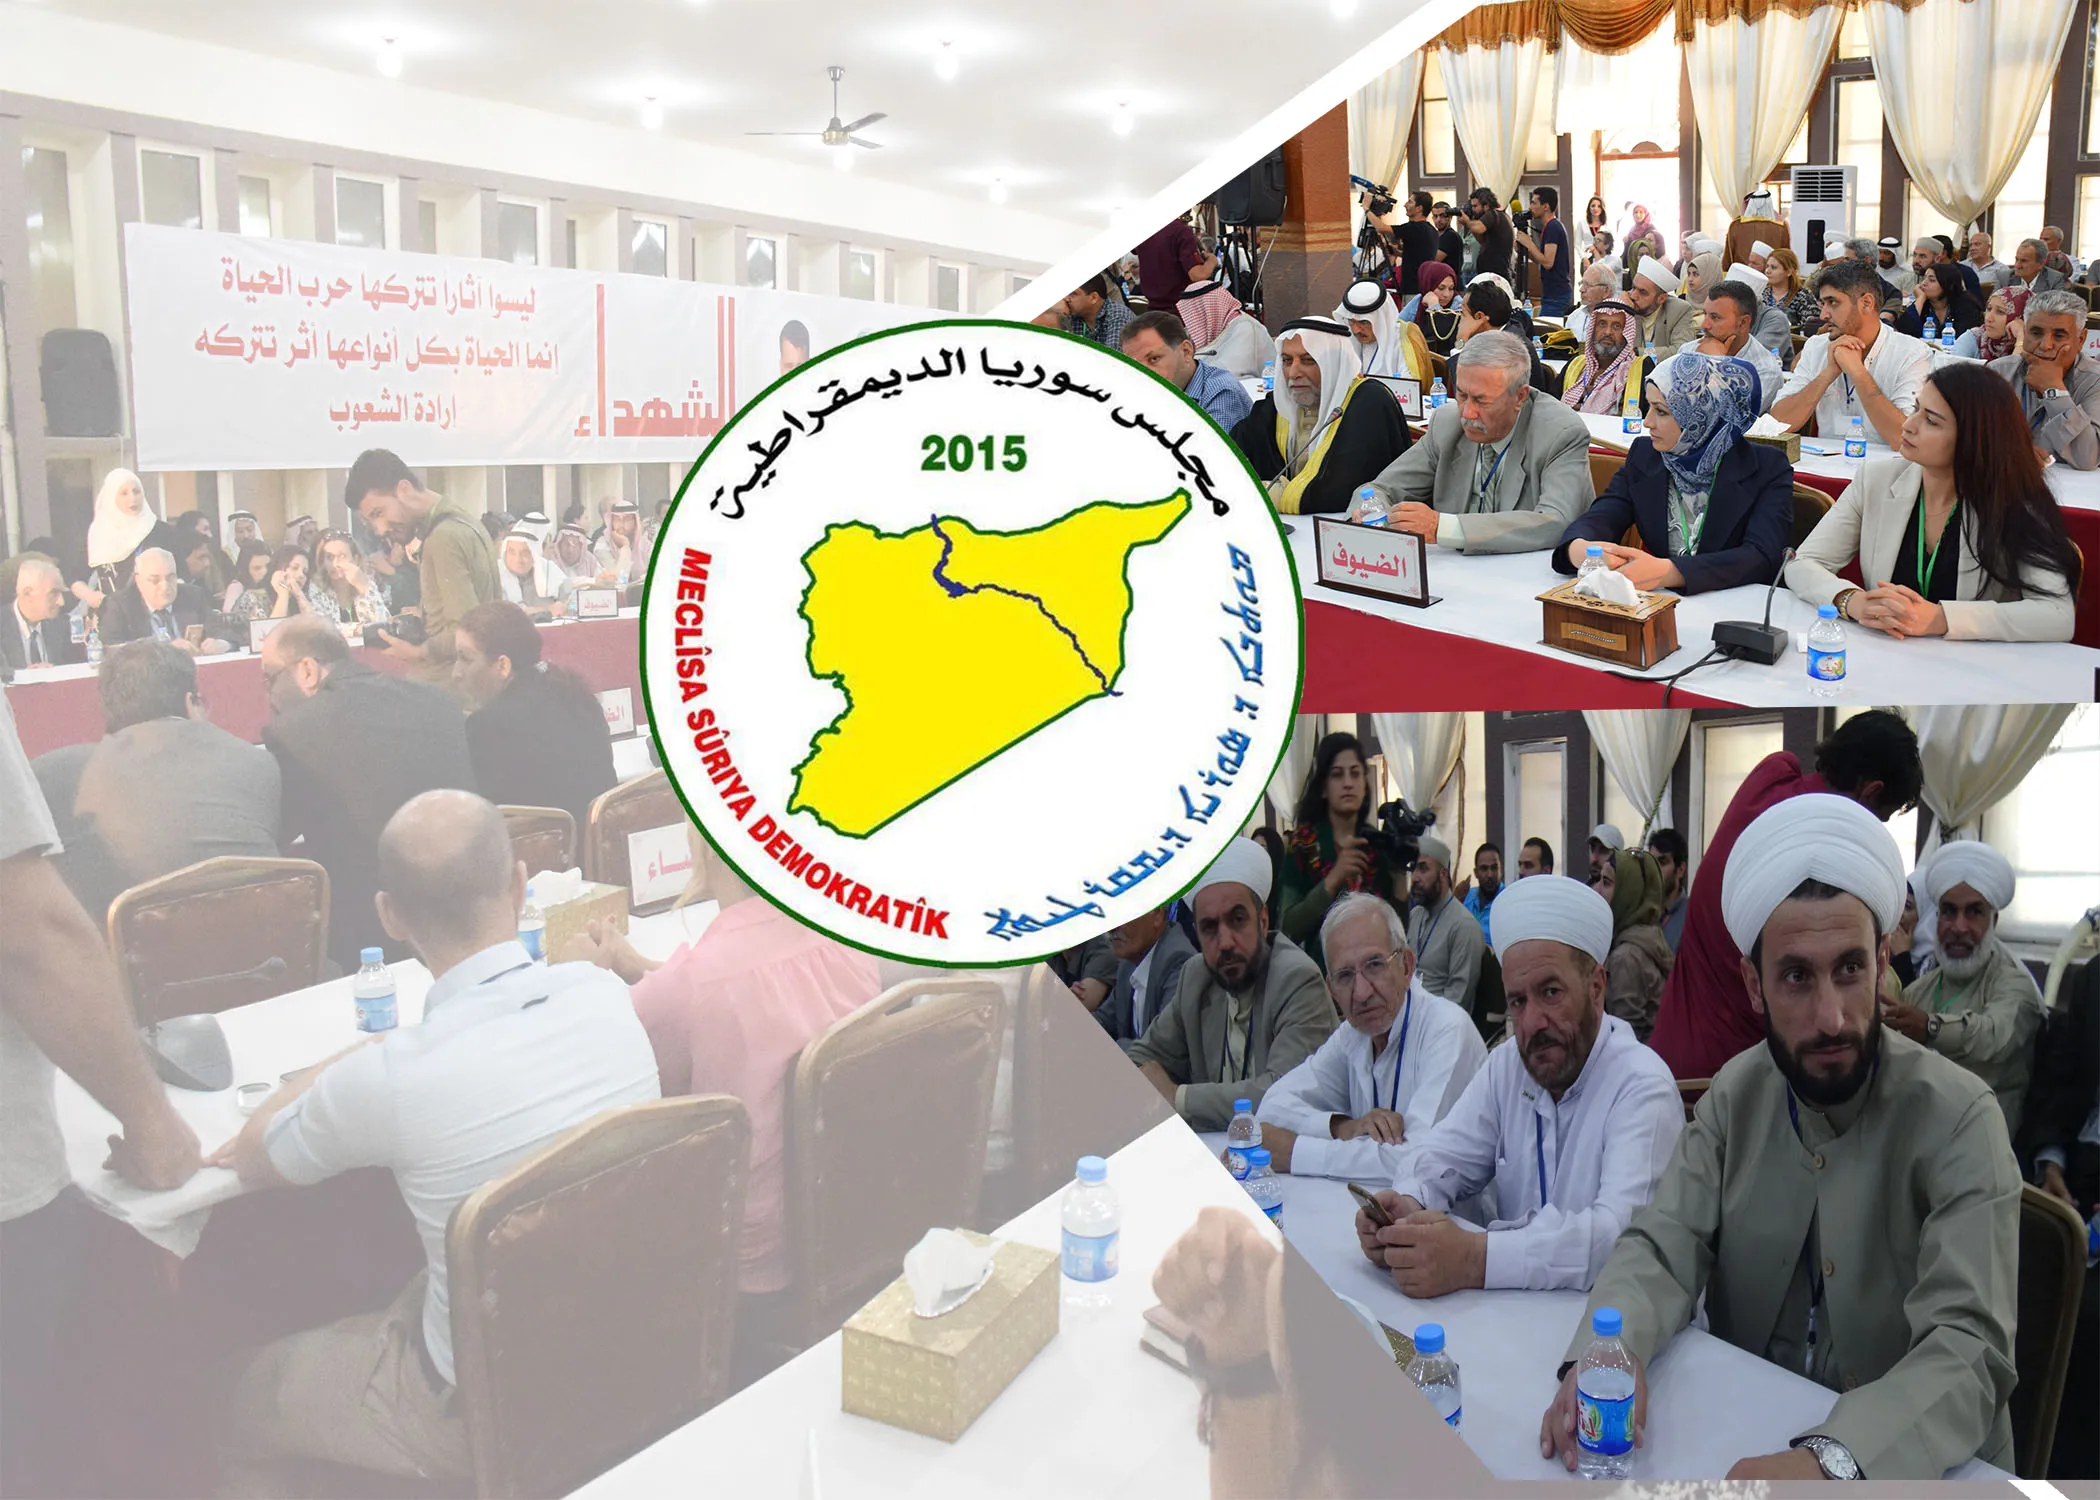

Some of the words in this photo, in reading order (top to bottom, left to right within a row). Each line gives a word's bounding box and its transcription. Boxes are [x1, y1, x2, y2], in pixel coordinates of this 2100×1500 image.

[220, 256, 293, 304] الحياة
[297, 275, 353, 308] حرب
[360, 273, 438, 312] تتركها
[489, 283, 536, 322] ليسوا
[194, 324, 279, 364] تتركه
[405, 335, 461, 375] بكل
[465, 336, 521, 376] الحياة
[574, 283, 736, 437] الشهداء
[328, 387, 409, 432] الشعوب
[1332, 541, 1407, 579] الضيوف
